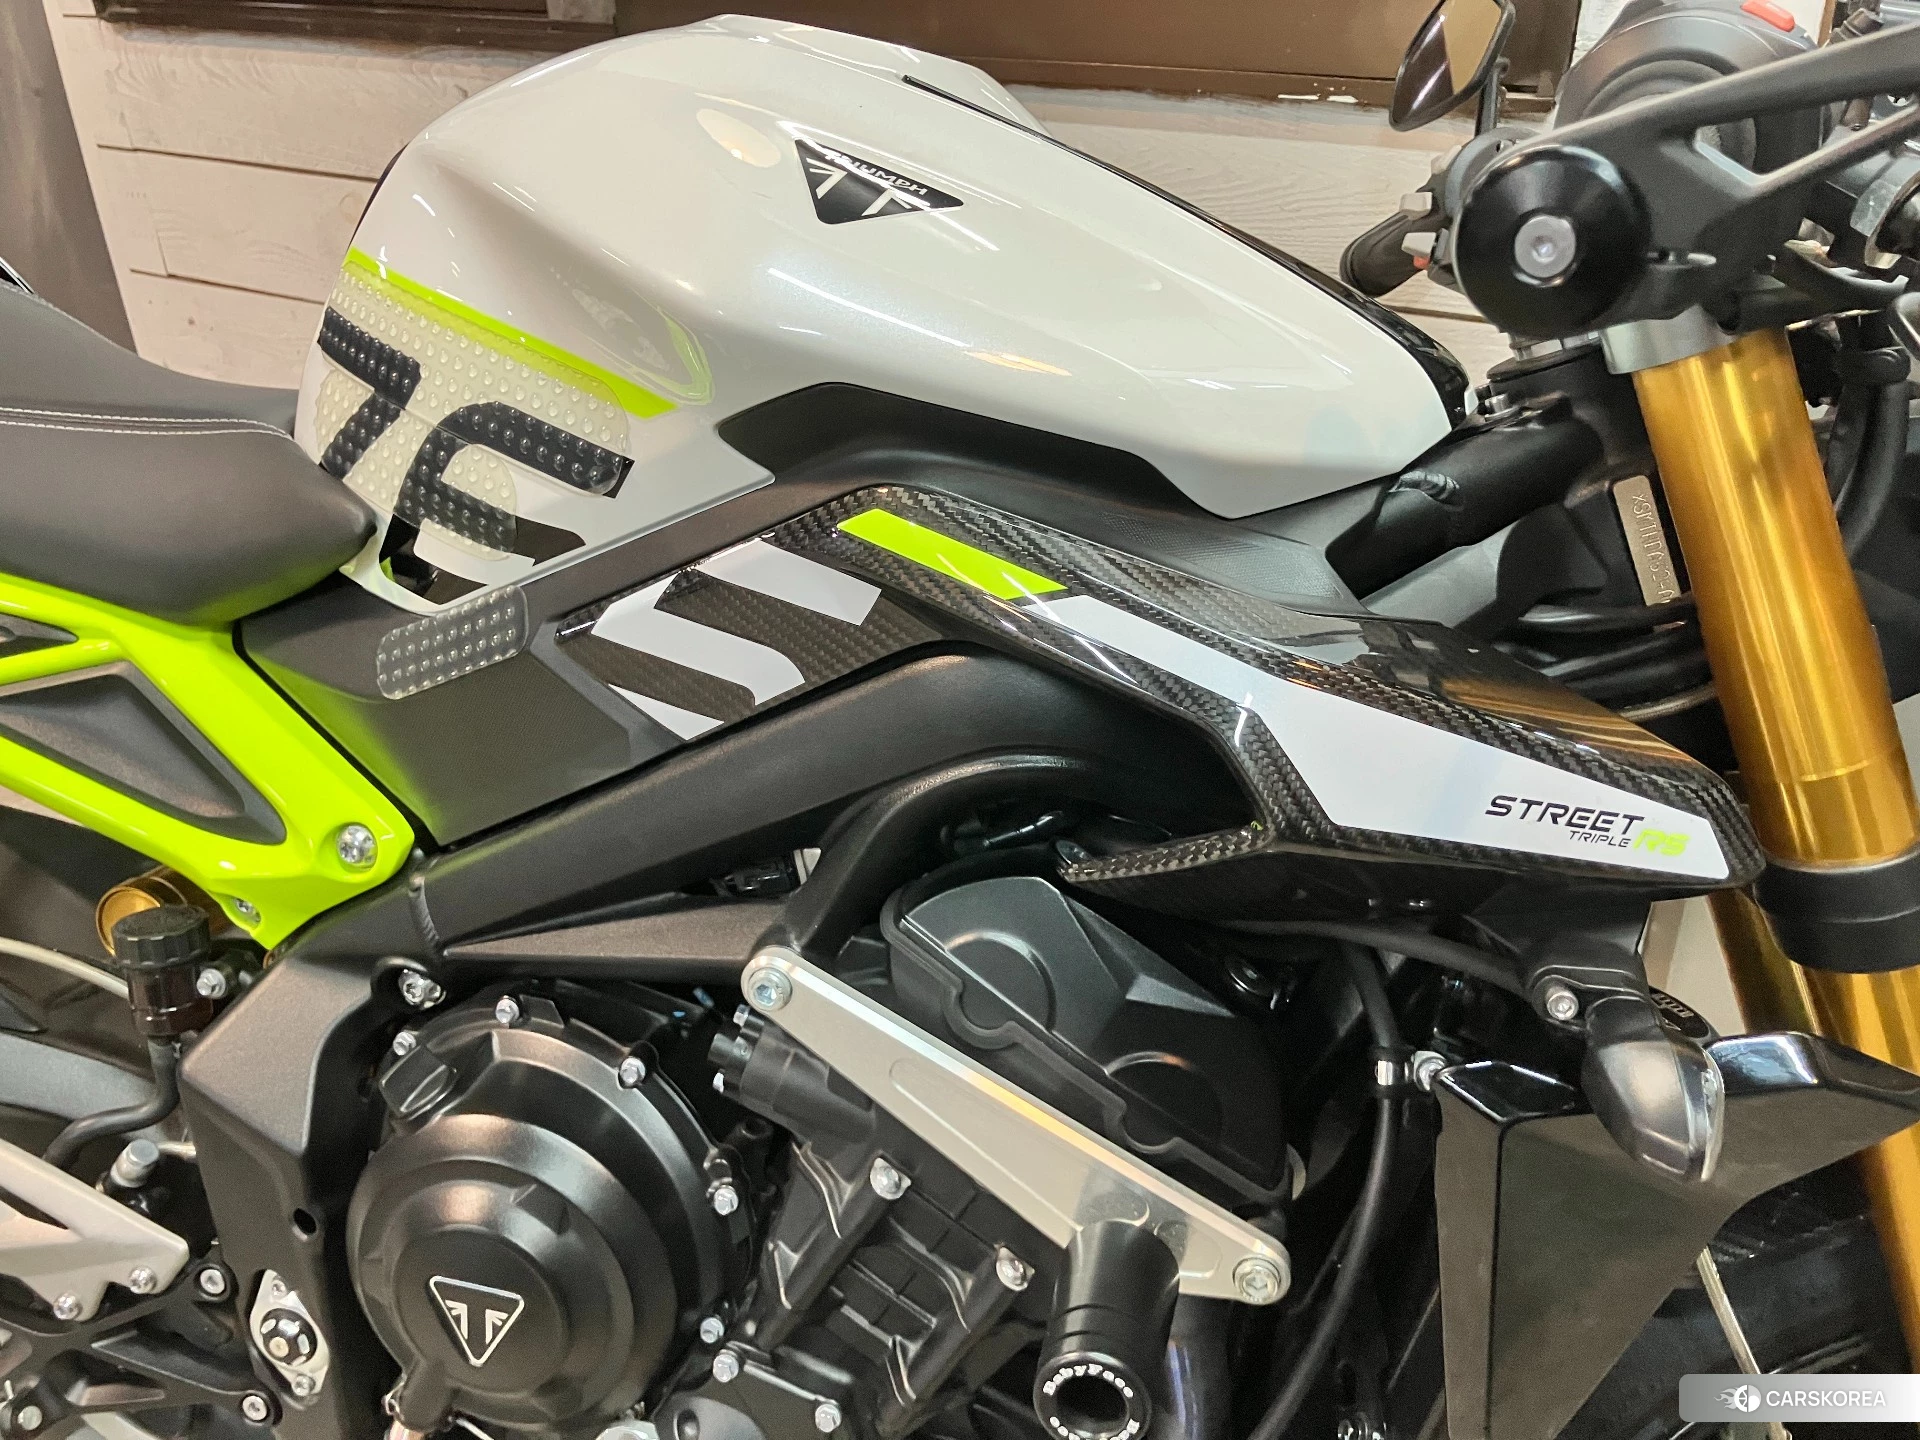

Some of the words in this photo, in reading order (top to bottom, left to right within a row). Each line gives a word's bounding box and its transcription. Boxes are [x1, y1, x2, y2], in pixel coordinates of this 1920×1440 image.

[1484, 795, 1645, 835] STREET
[1569, 830, 1632, 848] TRIPLE
[1634, 829, 1690, 856] RS
